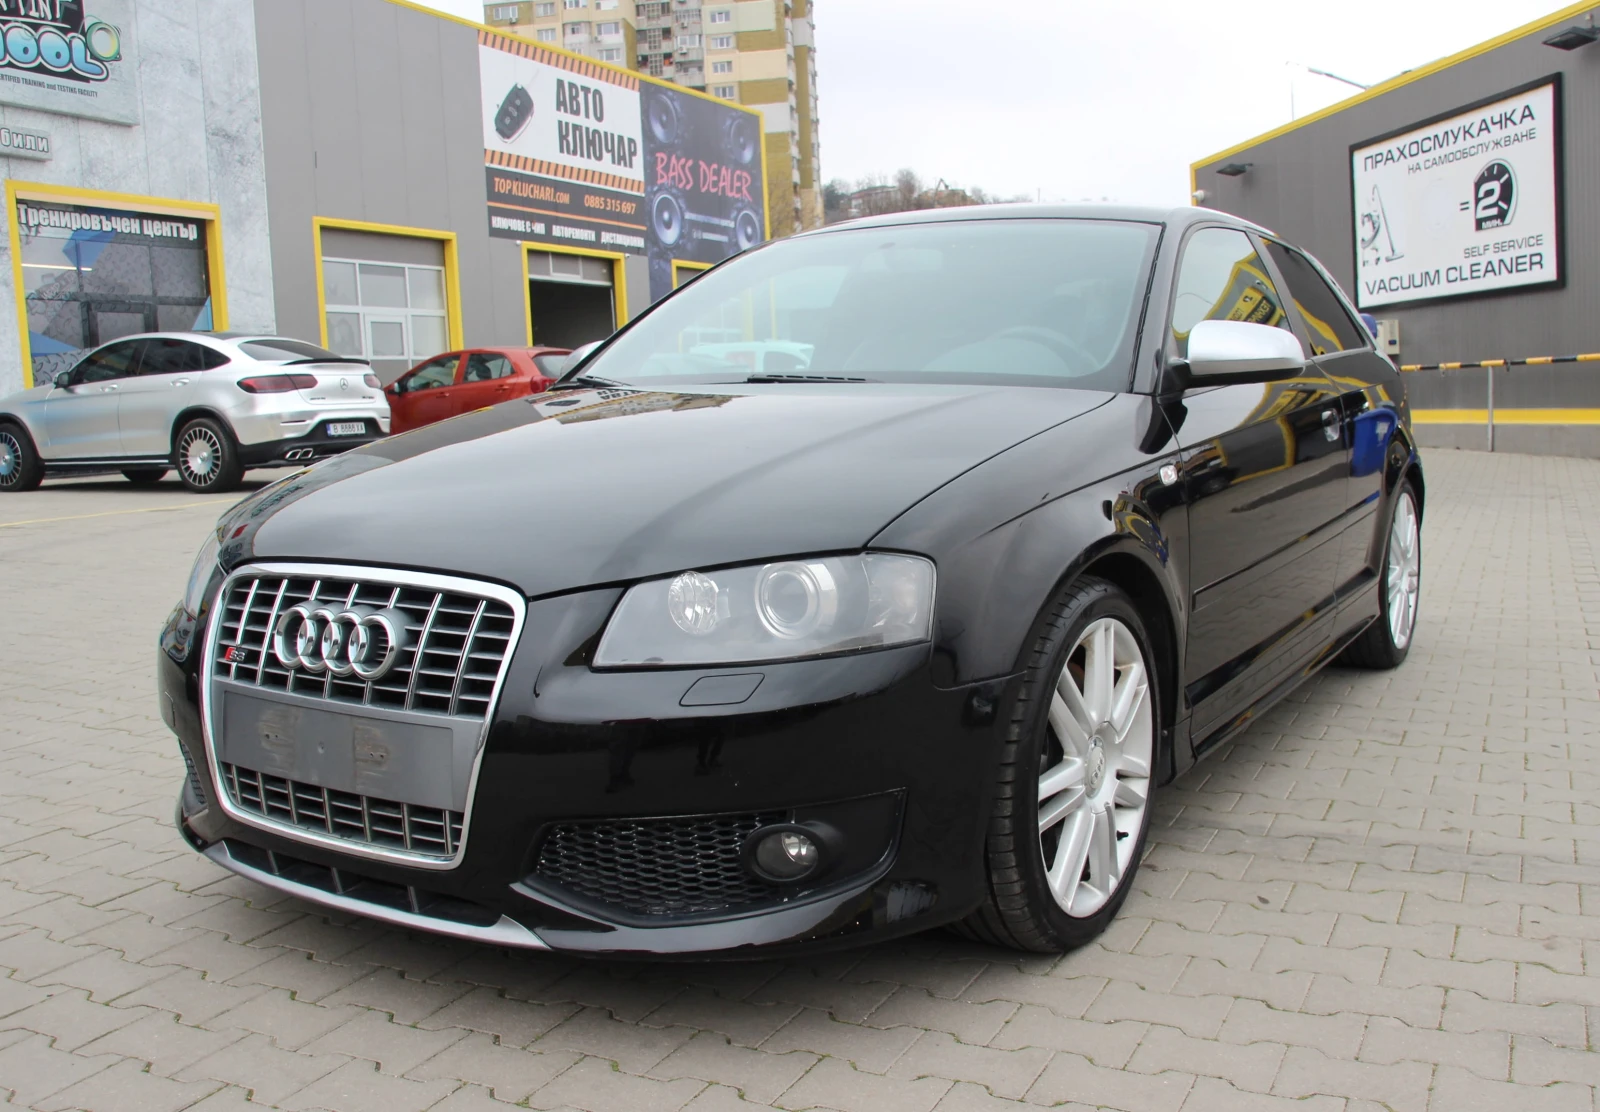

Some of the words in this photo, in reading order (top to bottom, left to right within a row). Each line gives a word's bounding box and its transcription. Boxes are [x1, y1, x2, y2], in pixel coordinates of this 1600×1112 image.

[21, 78, 45, 88] TRAINING
[57, 85, 77, 94] TESTING
[78, 89, 98, 97] FACILITY
[555, 78, 604, 123] АВТО
[557, 119, 637, 170] КЛЮЧАР
[1364, 104, 1536, 172] ПРАХОСМУКАЧКА
[1408, 163, 1422, 175] НА
[1423, 128, 1537, 170] САМООБСЛУЖВАНЕ
[655, 151, 694, 190] BASS
[698, 159, 752, 202] DEALER
[584, 194, 604, 209] 0885
[605, 198, 621, 212] 315
[621, 201, 636, 215] 697
[1476, 180, 1501, 219] 2
[18, 204, 140, 234] Тренировъчен
[143, 219, 198, 241] център
[1463, 244, 1491, 259] SELF
[1492, 234, 1544, 254] SERVICE
[1365, 269, 1441, 296] VACUUM
[1445, 252, 1544, 284] CLEANER
